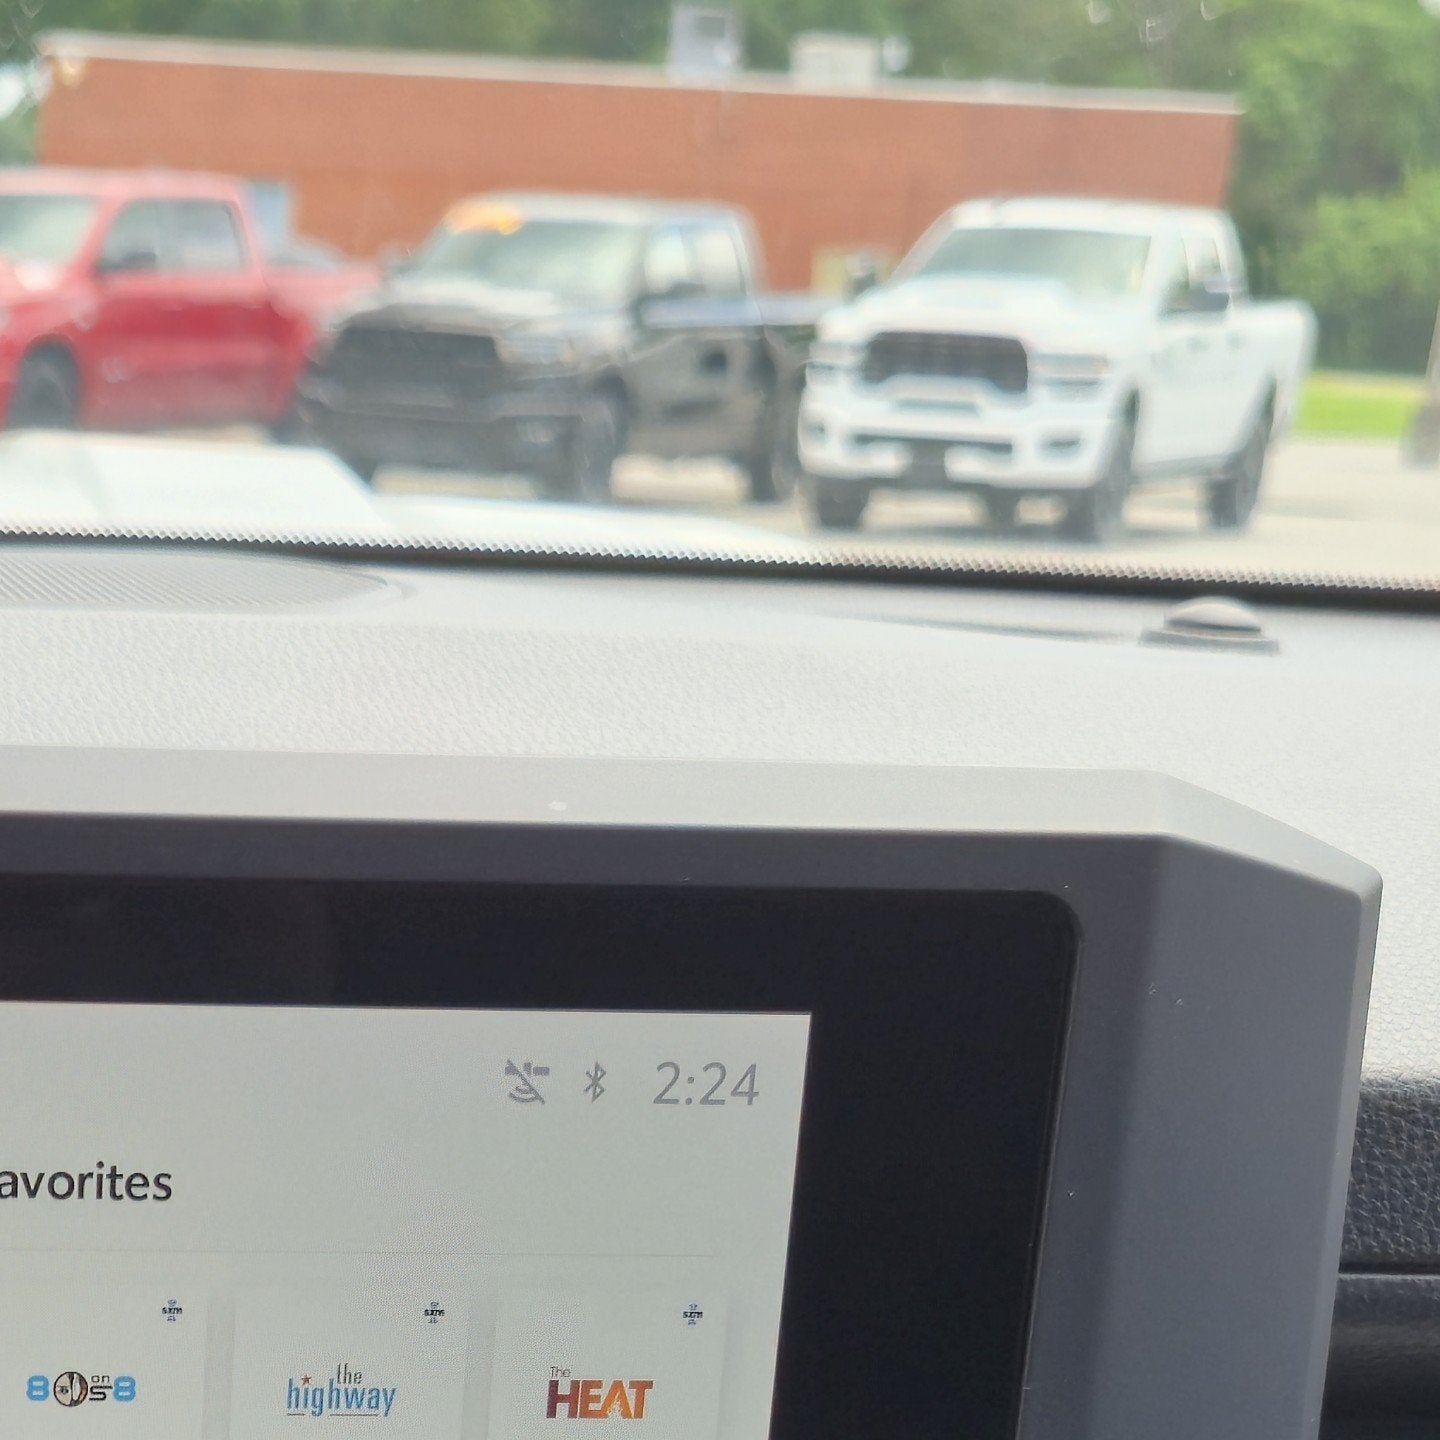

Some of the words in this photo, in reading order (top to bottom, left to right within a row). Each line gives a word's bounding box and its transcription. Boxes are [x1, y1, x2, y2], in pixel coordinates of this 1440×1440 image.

[652, 1061, 761, 1107] 2:24
[336, 1362, 363, 1385] the
[286, 1377, 397, 1417] highway
[545, 1379, 655, 1419] HEAT
